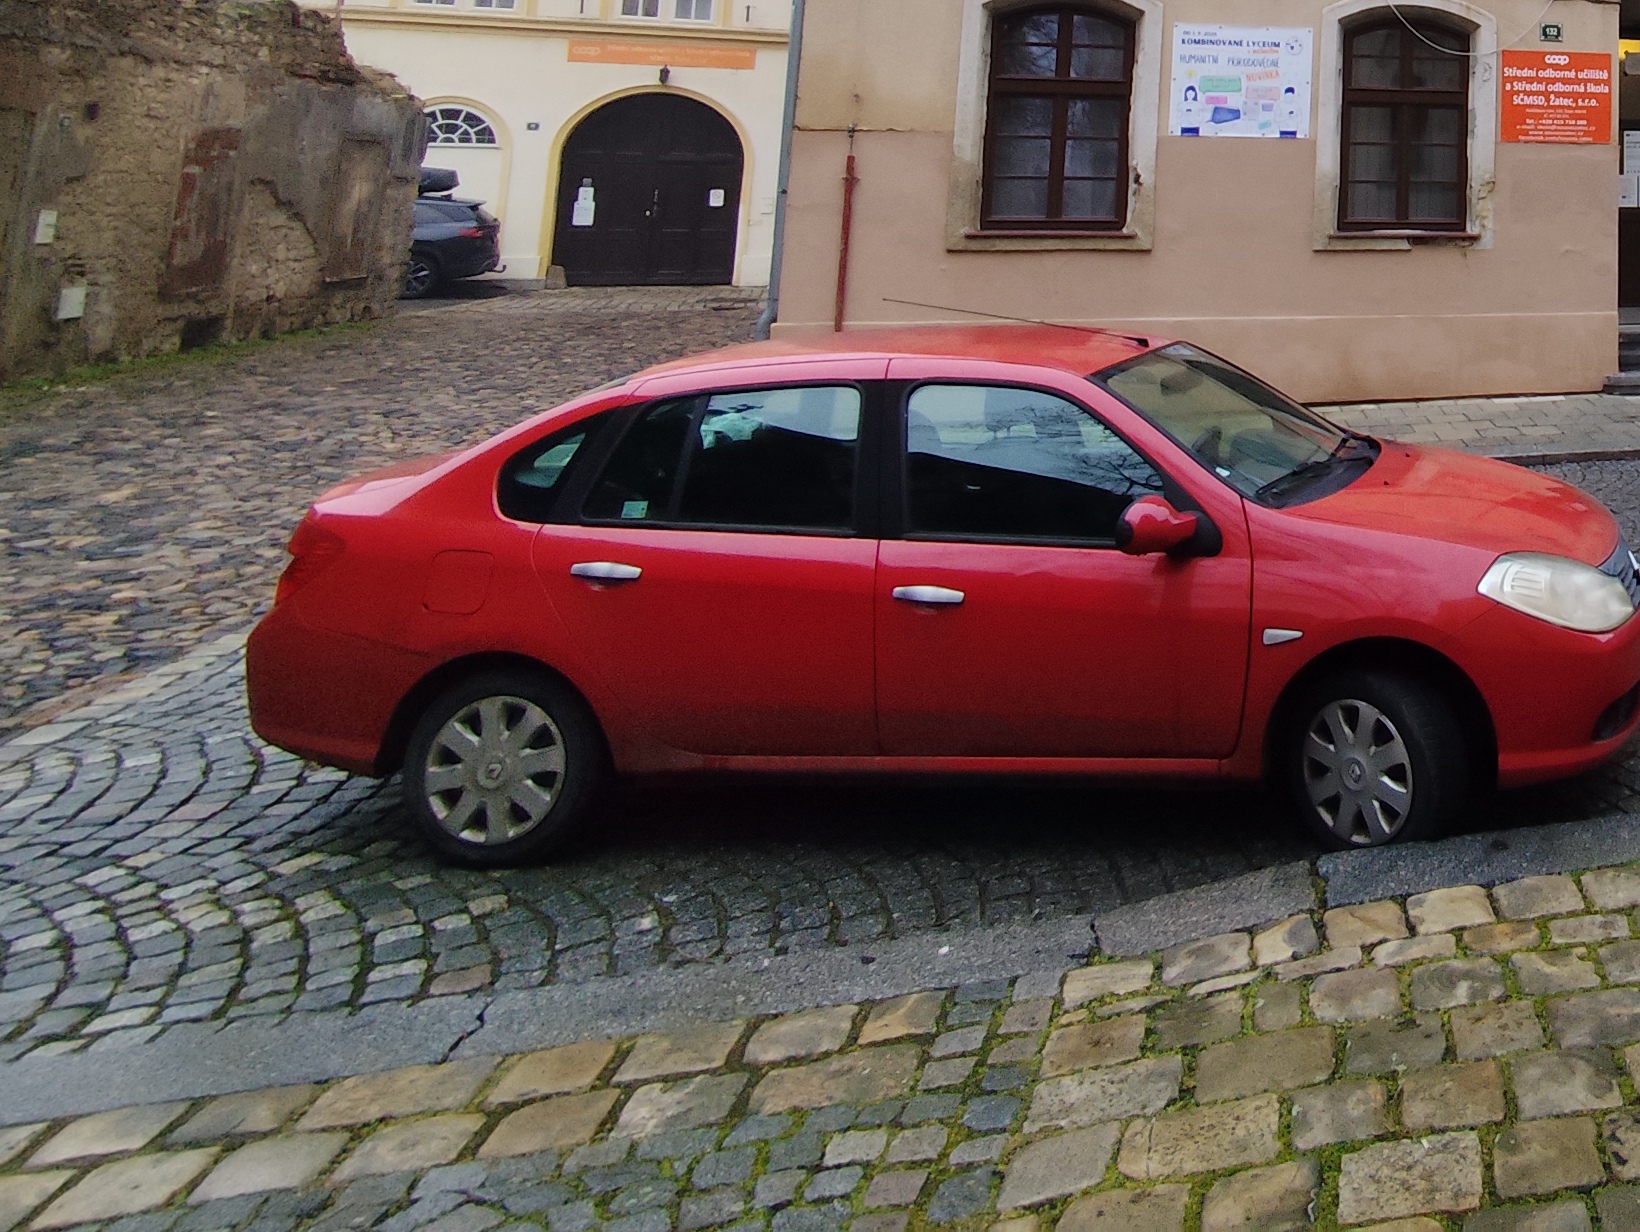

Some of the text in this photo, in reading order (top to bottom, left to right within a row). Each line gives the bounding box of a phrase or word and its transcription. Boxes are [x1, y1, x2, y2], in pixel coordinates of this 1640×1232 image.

[1182, 38, 1280, 48] KOMBINOVANÉ LYCEUM
[1180, 54, 1219, 64] HUMANITNÍ
[1544, 55, 1569, 65] coop
[1246, 69, 1280, 82] NOVINKA
[1504, 68, 1608, 79] Střední odborné učiliště
[1505, 81, 1609, 93] a Střední odborná škola
[1513, 94, 1599, 107] SČMSD, Žatec, s.r.o.
